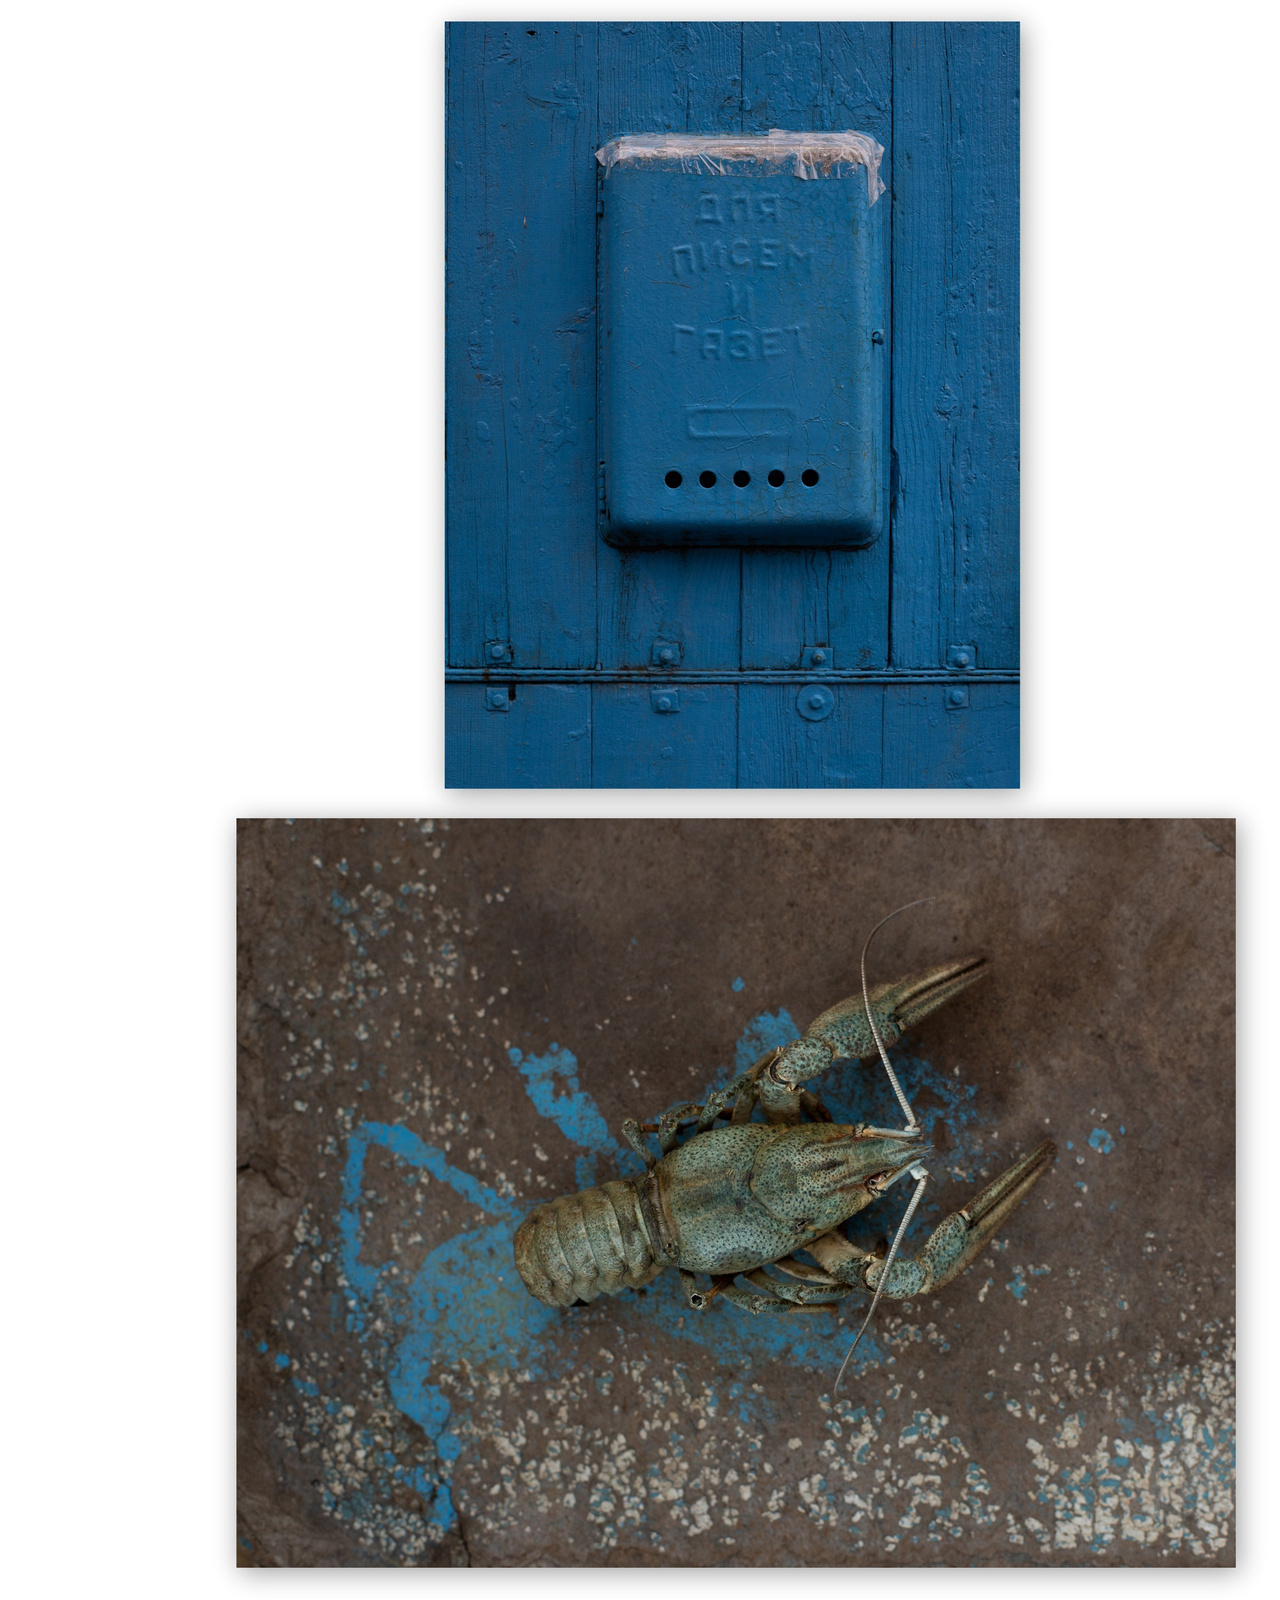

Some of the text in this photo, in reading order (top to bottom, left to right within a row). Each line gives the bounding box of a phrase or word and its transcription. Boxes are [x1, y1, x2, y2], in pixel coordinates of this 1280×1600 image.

[695, 193, 780, 224] ДЛЯ
[672, 238, 814, 276] ПИСЕМ
[671, 322, 810, 360] ГАЗЕТ
